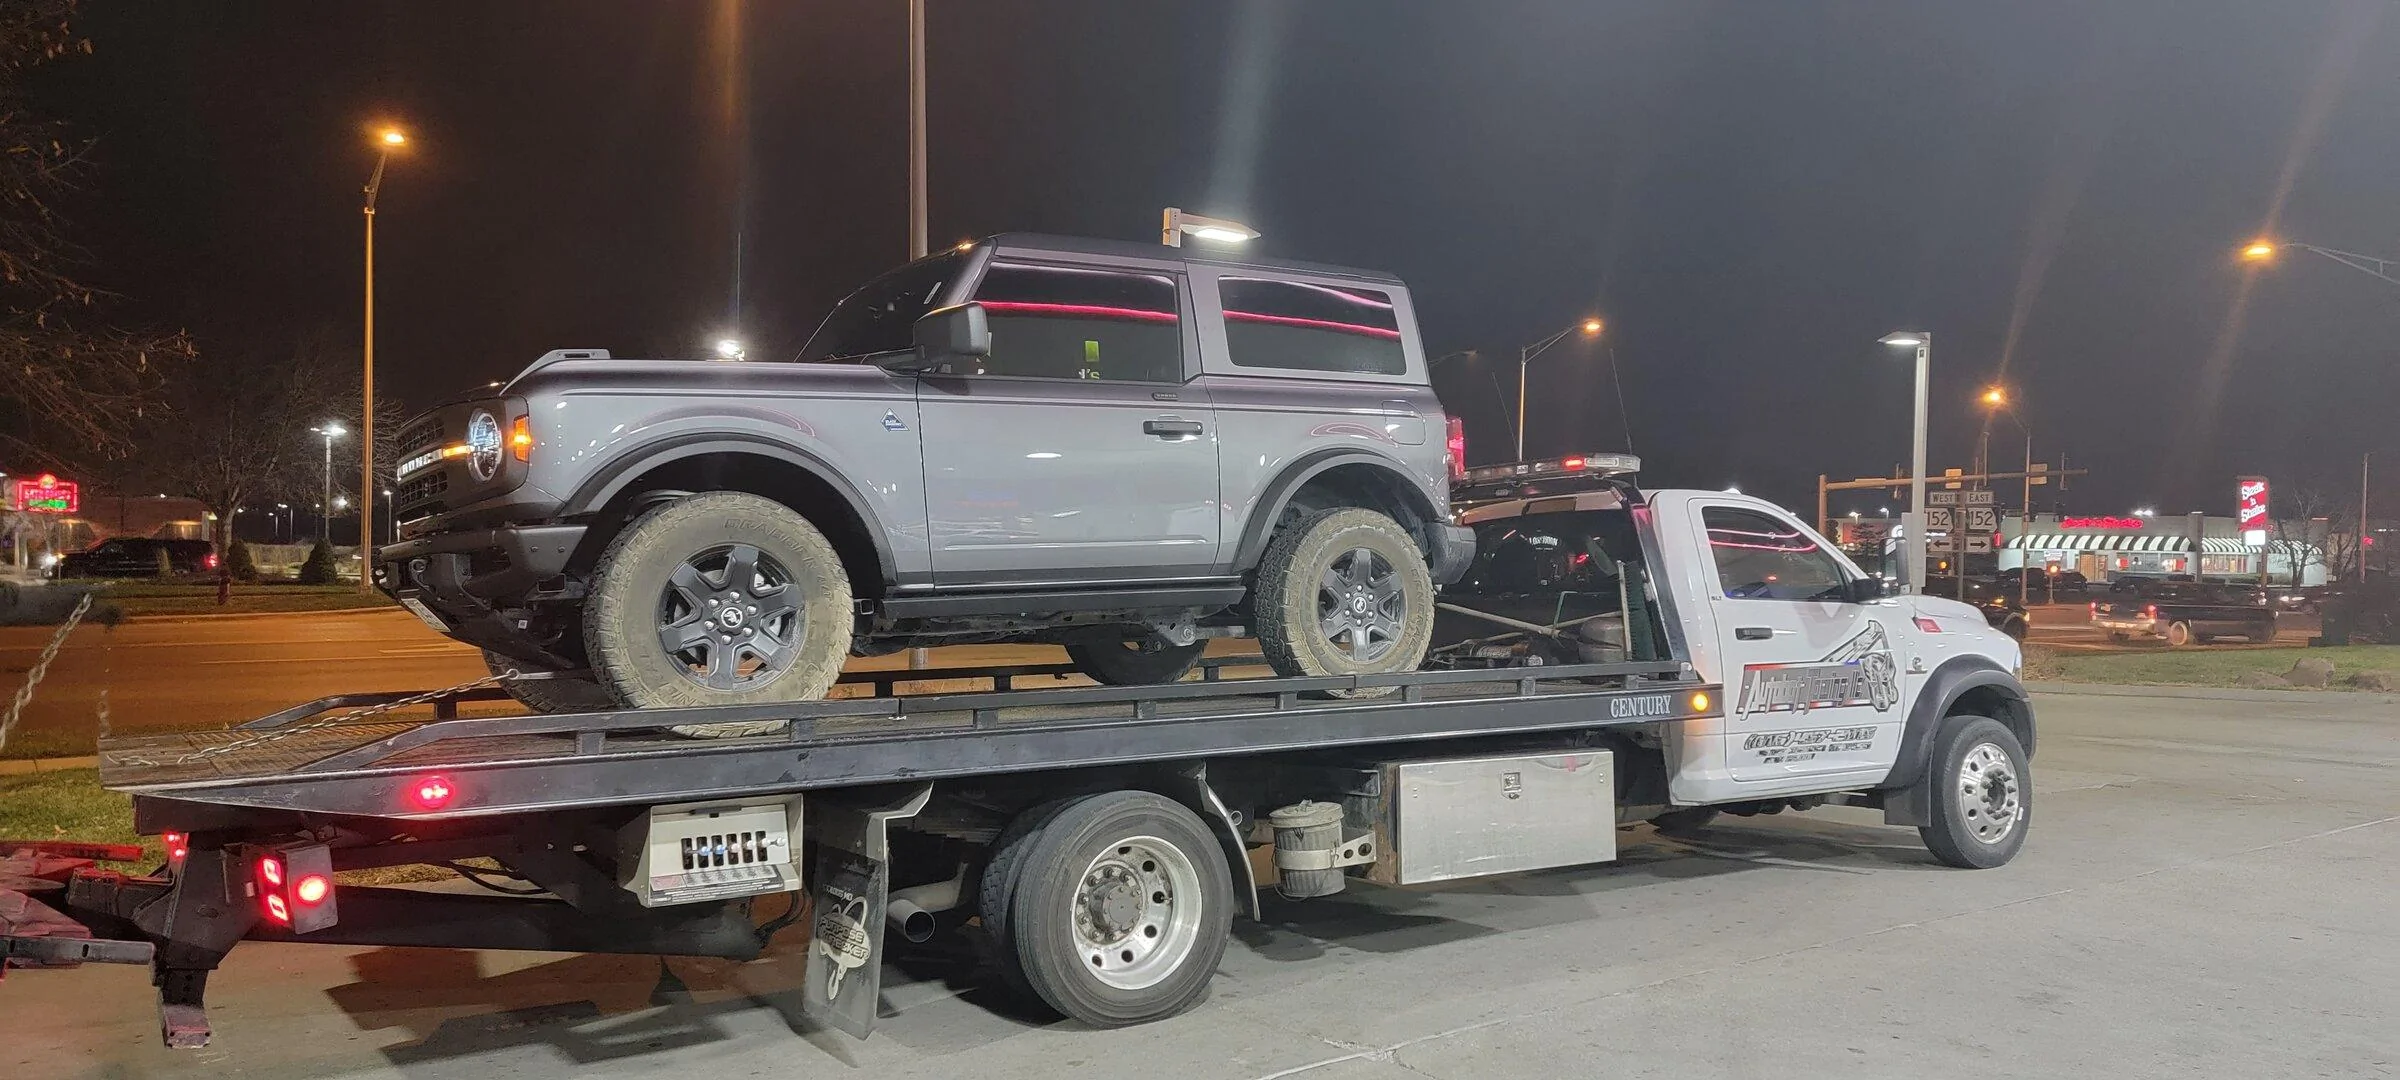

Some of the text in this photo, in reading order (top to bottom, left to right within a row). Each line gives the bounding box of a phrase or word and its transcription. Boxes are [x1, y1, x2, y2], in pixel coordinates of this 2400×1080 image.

[1932, 493, 1954, 503] WEST
[1969, 493, 1990, 503] EAST
[1926, 511, 1950, 526] 152
[1970, 511, 1994, 526] 152
[1610, 695, 1672, 718] CENTURY
